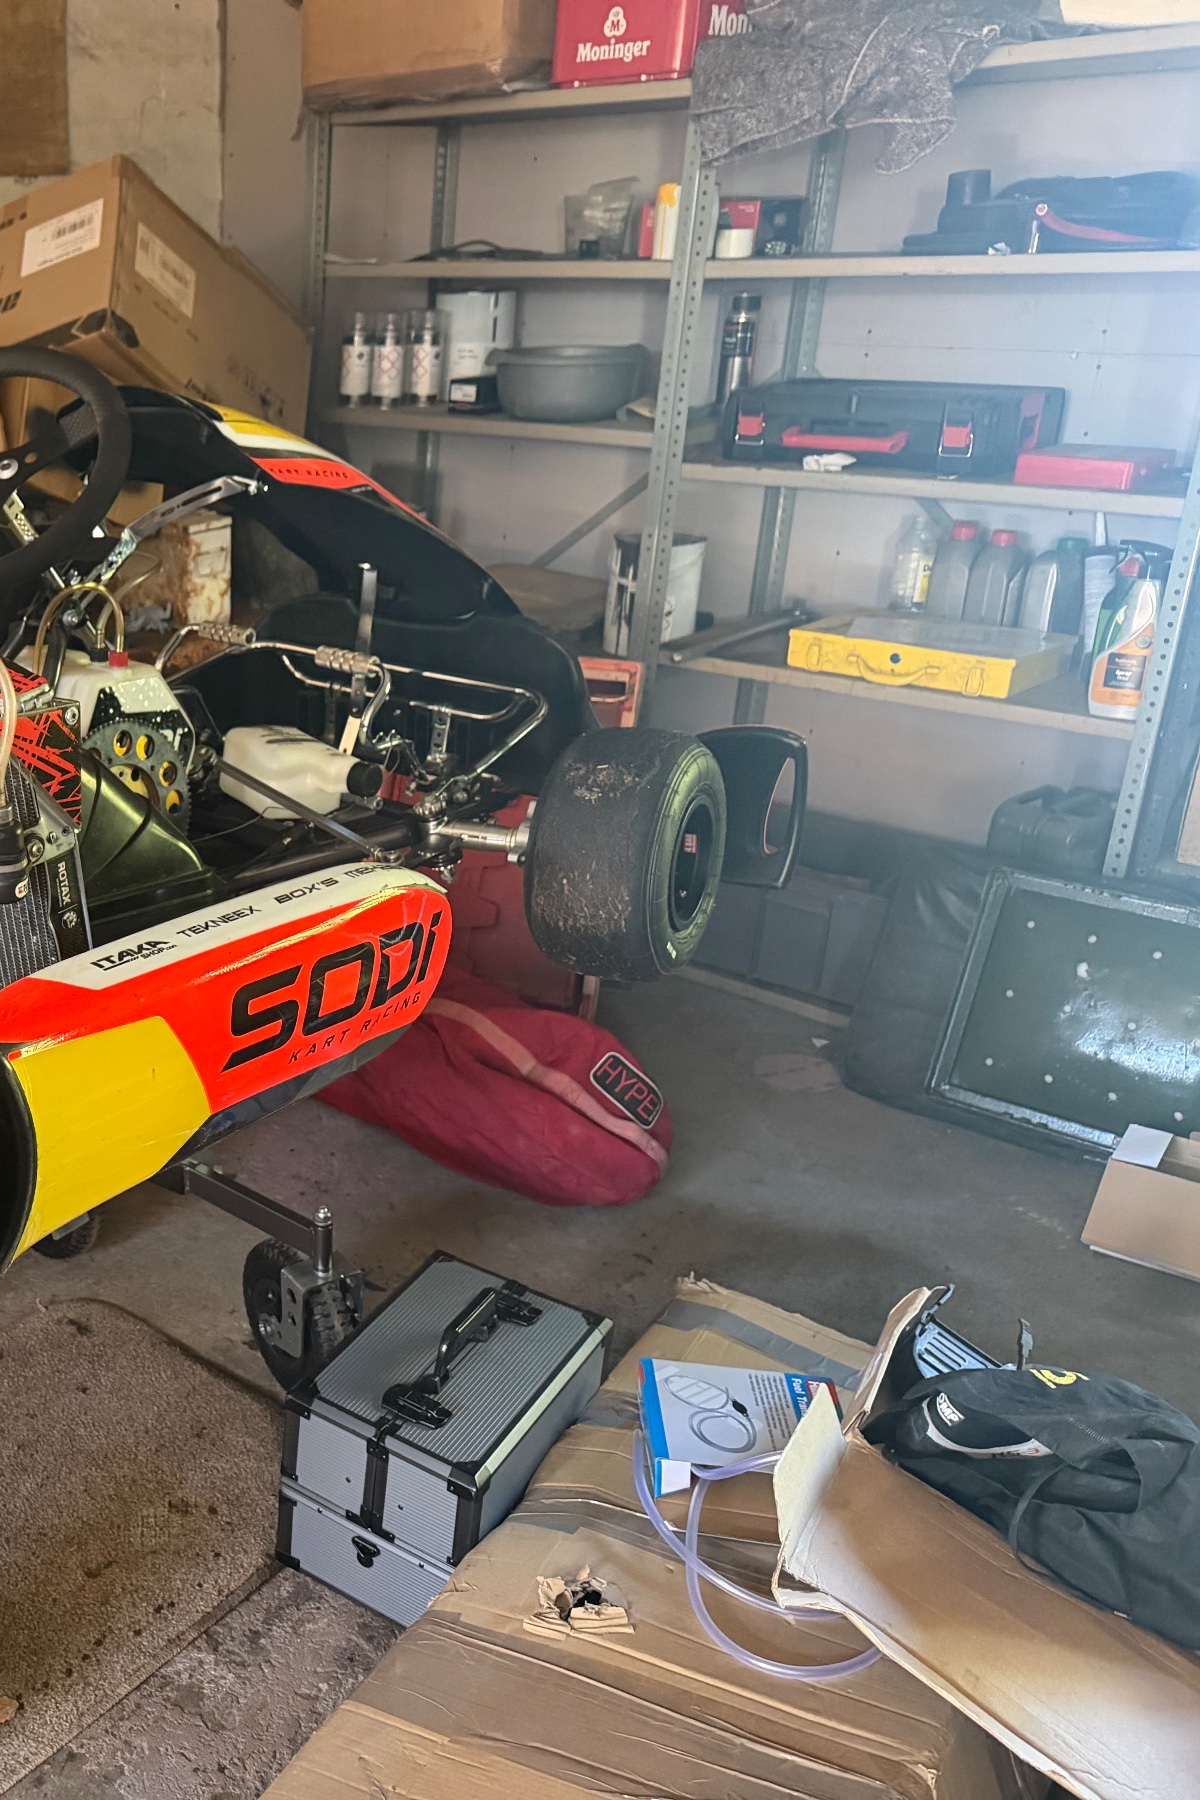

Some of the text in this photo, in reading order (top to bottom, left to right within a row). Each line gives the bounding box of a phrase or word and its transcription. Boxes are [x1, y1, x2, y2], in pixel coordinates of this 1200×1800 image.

[708, 4, 752, 37] Mon
[576, 38, 651, 63] Moninger
[306, 469, 349, 479] RACING
[57, 861, 71, 906] ROTAX
[274, 877, 340, 905] BOX'S
[176, 905, 263, 938] TEKNEEX
[90, 939, 171, 969] ITAKA
[287, 1028, 351, 1065] KART
[597, 1057, 659, 1120] HYPE
[791, 1377, 806, 1394] Fuel
[936, 1392, 960, 1423] OMP
